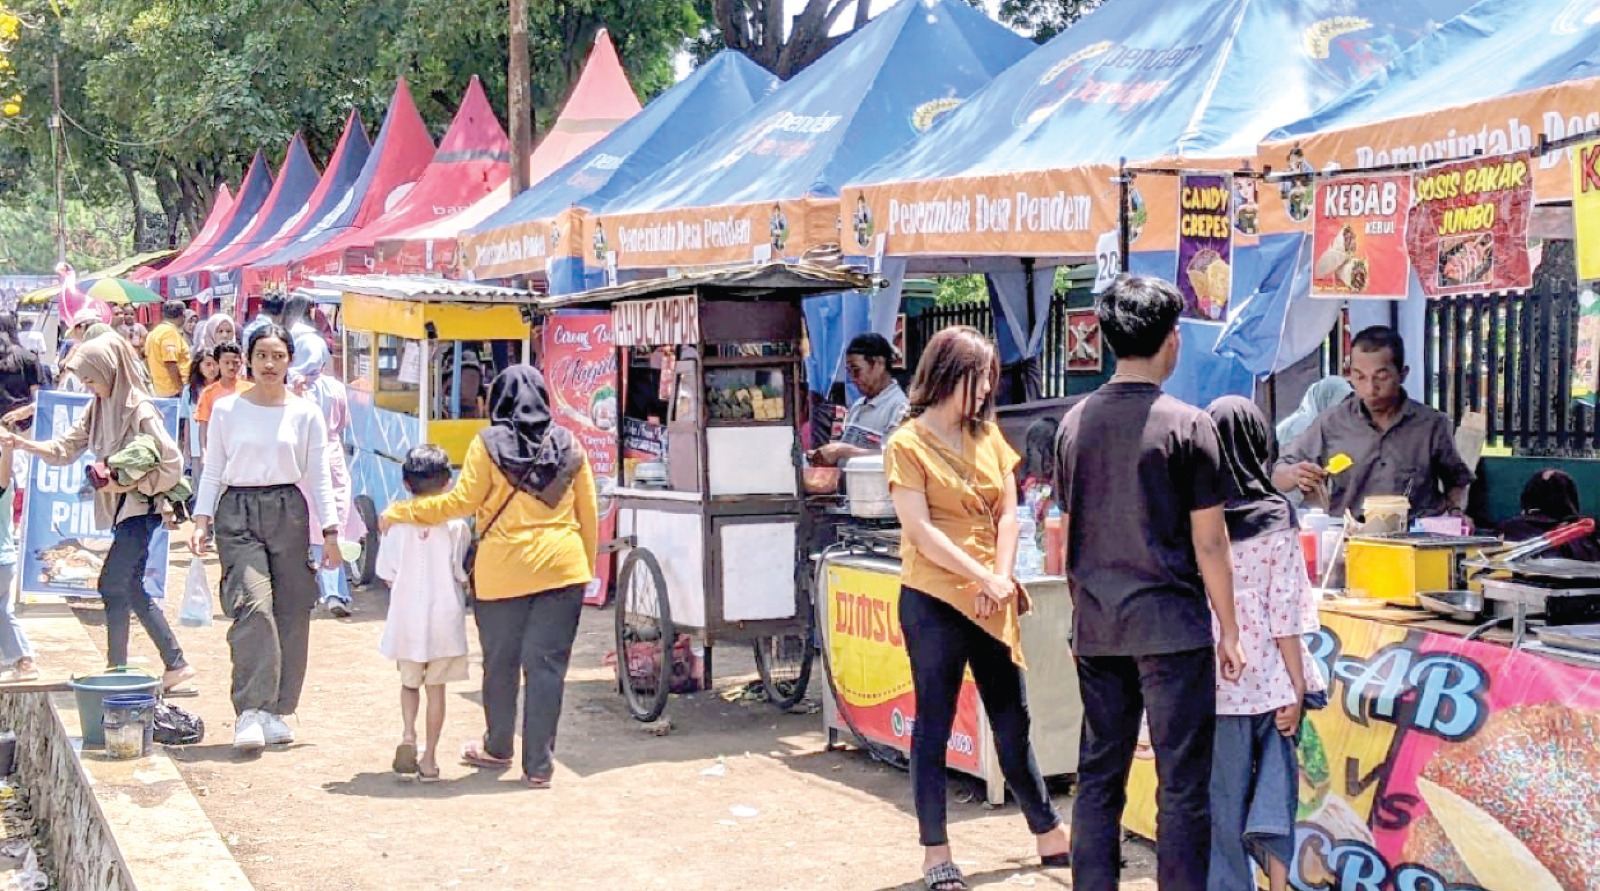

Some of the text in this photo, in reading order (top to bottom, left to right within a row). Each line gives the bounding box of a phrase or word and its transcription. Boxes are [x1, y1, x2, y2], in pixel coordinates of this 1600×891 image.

[1416, 160, 1528, 201] SOSIS BAKAR
[1015, 190, 1092, 233] Pendem
[1181, 185, 1230, 212] CANDY
[1324, 181, 1398, 218] KEBAB
[1181, 213, 1230, 238] CREPES
[1438, 203, 1495, 236] JUMBO
[1098, 250, 1119, 281] 20
